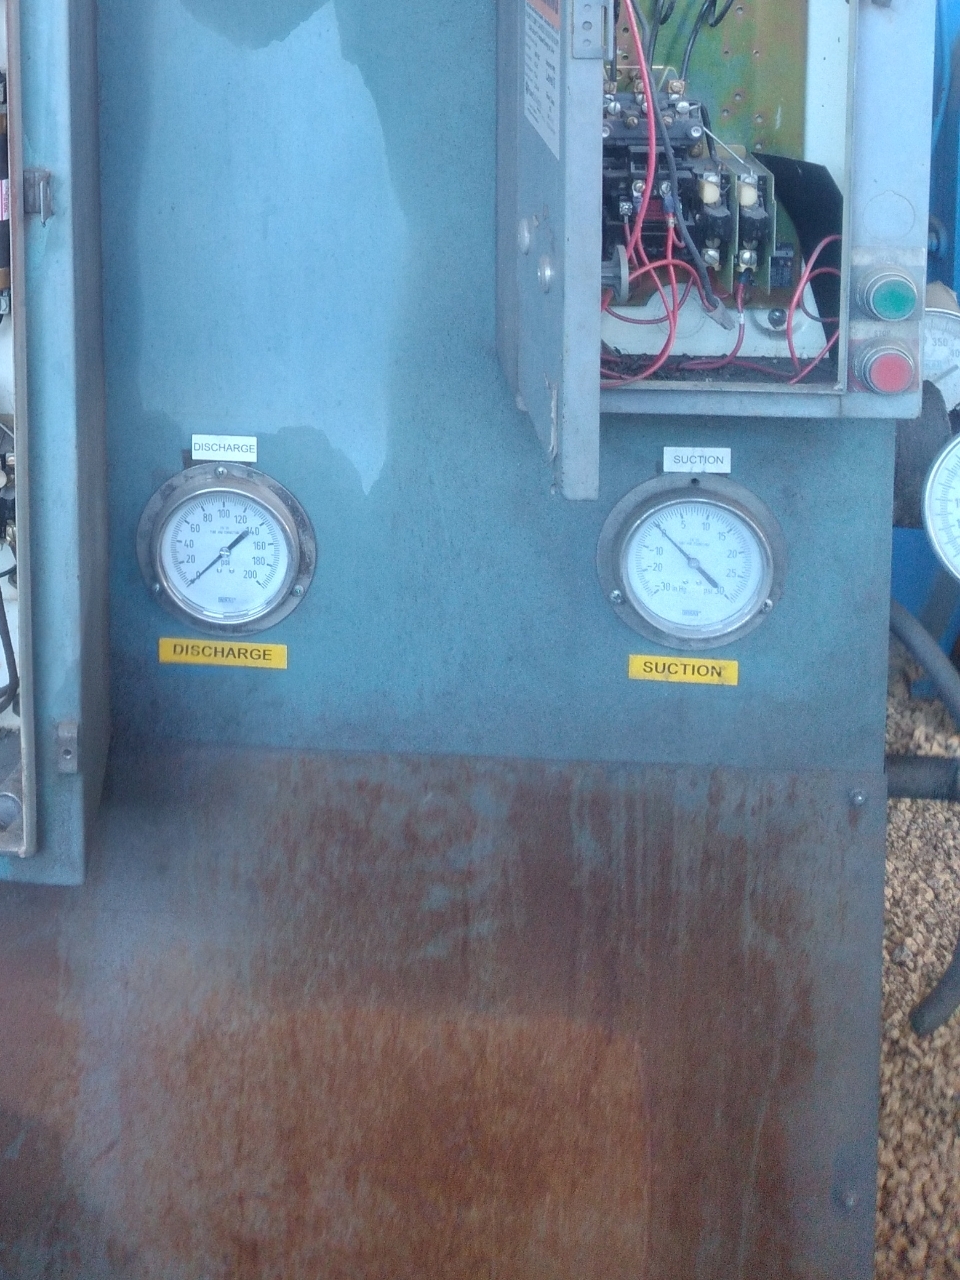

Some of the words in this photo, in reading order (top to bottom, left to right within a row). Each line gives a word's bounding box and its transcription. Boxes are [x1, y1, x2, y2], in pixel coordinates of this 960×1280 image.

[932, 338, 948, 347] 350
[194, 443, 256, 454] DISCHARGE
[673, 455, 724, 465] SUCTION
[203, 513, 213, 523] 80
[218, 510, 231, 519] 100
[234, 515, 248, 524] 120
[191, 524, 200, 533] 60
[681, 520, 686, 529] 5
[702, 522, 710, 530] 10
[247, 527, 260, 536] 140
[718, 532, 726, 541] 15
[184, 539, 194, 549] 40
[253, 541, 266, 551] 160
[649, 547, 663, 556] -10
[727, 550, 737, 558] 20
[186, 555, 196, 564] 20
[221, 559, 230, 567] psi
[252, 557, 265, 566] 180
[647, 562, 663, 572] -20
[243, 570, 257, 579] 200
[726, 569, 737, 577] 25
[655, 582, 671, 591] -30
[672, 585, 677, 593] in
[679, 585, 687, 594] Hg
[704, 587, 713, 595] psi
[714, 586, 725, 595] 30
[173, 644, 272, 661] DISCHARGE
[643, 661, 723, 678] SUCTION
